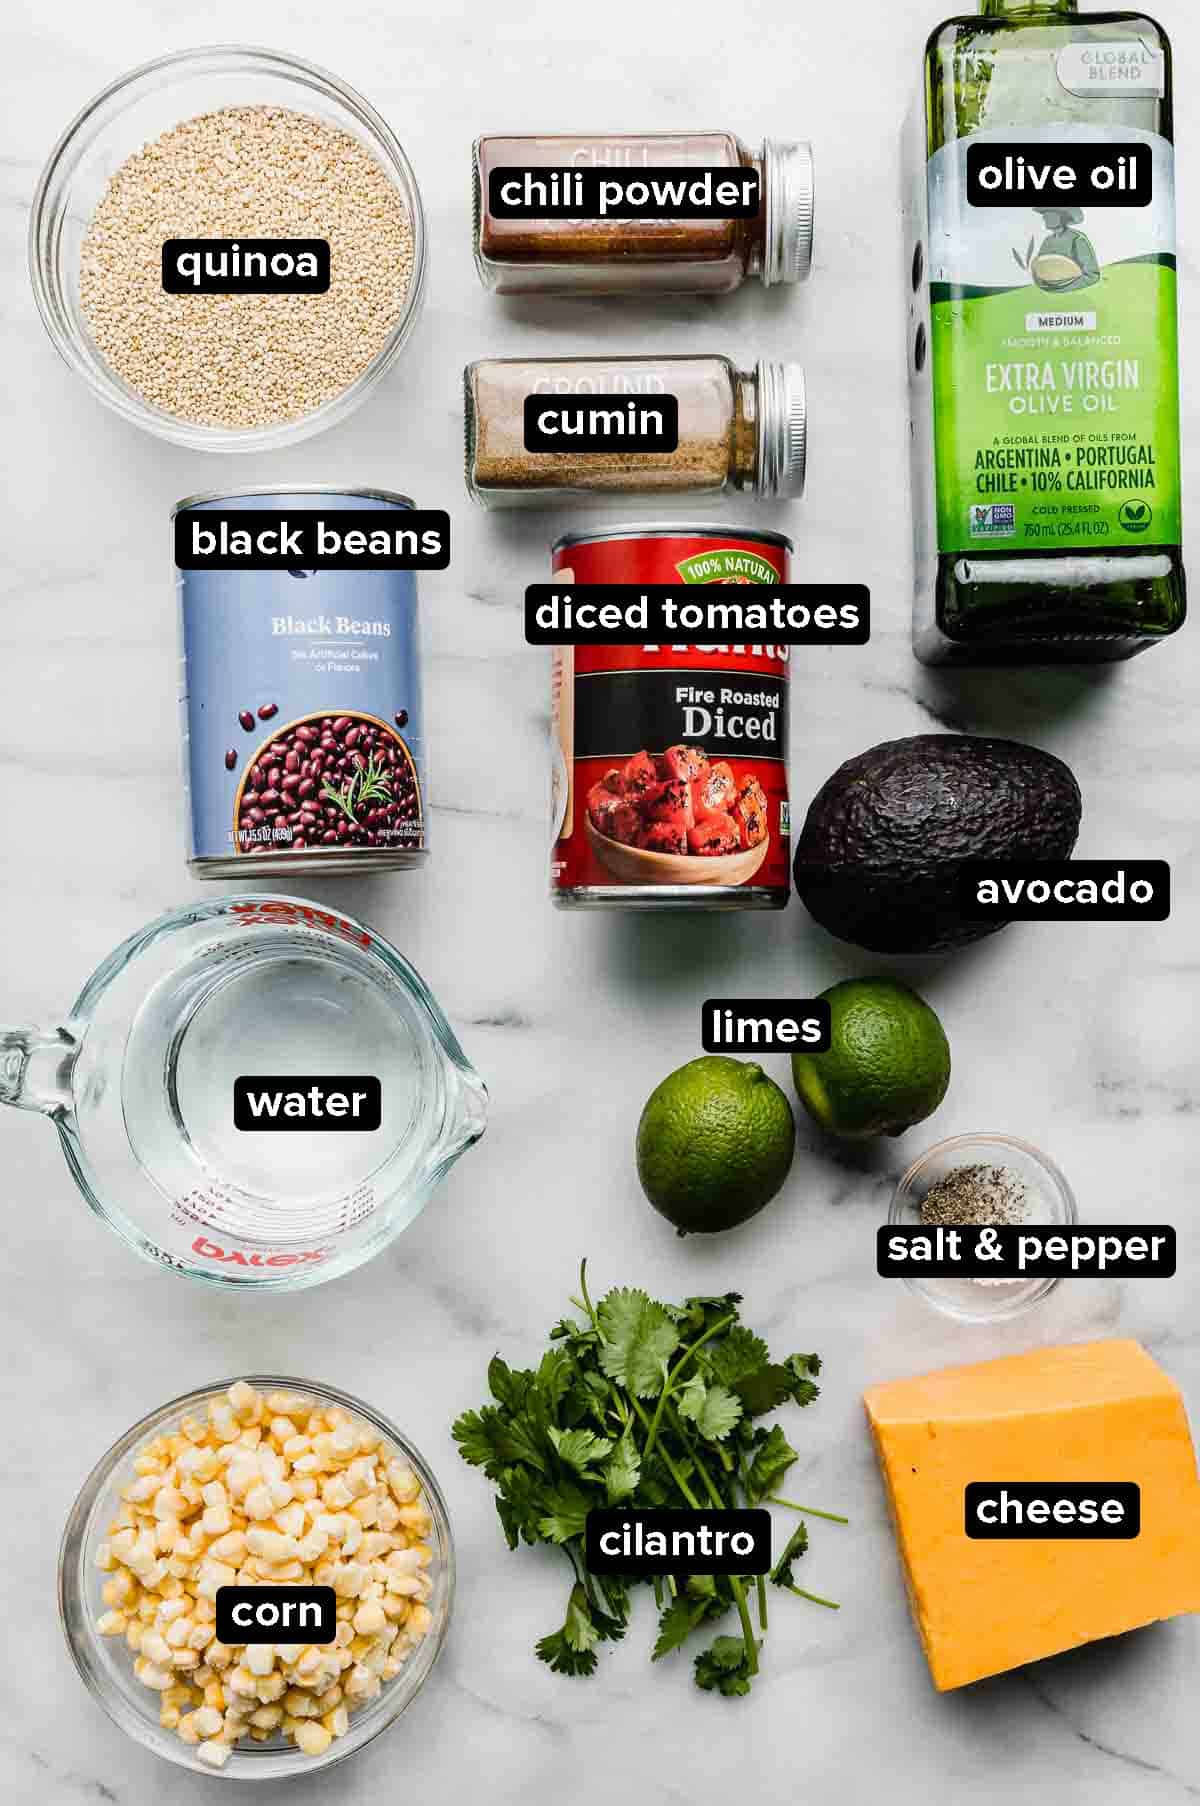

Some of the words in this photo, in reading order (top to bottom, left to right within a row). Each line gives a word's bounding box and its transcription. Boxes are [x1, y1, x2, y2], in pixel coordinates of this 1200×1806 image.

[1080, 51, 1148, 64] GLOBAL
[1088, 65, 1142, 80] BLEND
[1038, 316, 1084, 328] MEDIUM
[986, 361, 1056, 393] EXTRA
[1061, 359, 1139, 390] VIRGIN
[1008, 396, 1073, 414] OLIVE
[1082, 394, 1120, 412] OIL
[1002, 437, 1039, 445] GLOBAL
[1042, 435, 1069, 443] BLEND
[1072, 434, 1086, 443] OF
[1088, 434, 1108, 442] OILS
[1111, 433, 1136, 442] FROM
[975, 447, 1061, 470] ARGENTINA
[1076, 445, 1156, 466] PORTUGAL
[976, 472, 1017, 493] CHILE
[1032, 470, 1062, 491] 10%
[1066, 468, 1156, 491] CALIFORNIA
[1032, 506, 1058, 514] COLD
[1062, 504, 1100, 513] PRESSED
[687, 559, 721, 579] 100%
[271, 616, 332, 634] Black
[336, 616, 391, 637] Beans
[676, 687, 715, 703] Fire
[720, 688, 779, 708] Roasted
[682, 706, 777, 741] Diced
